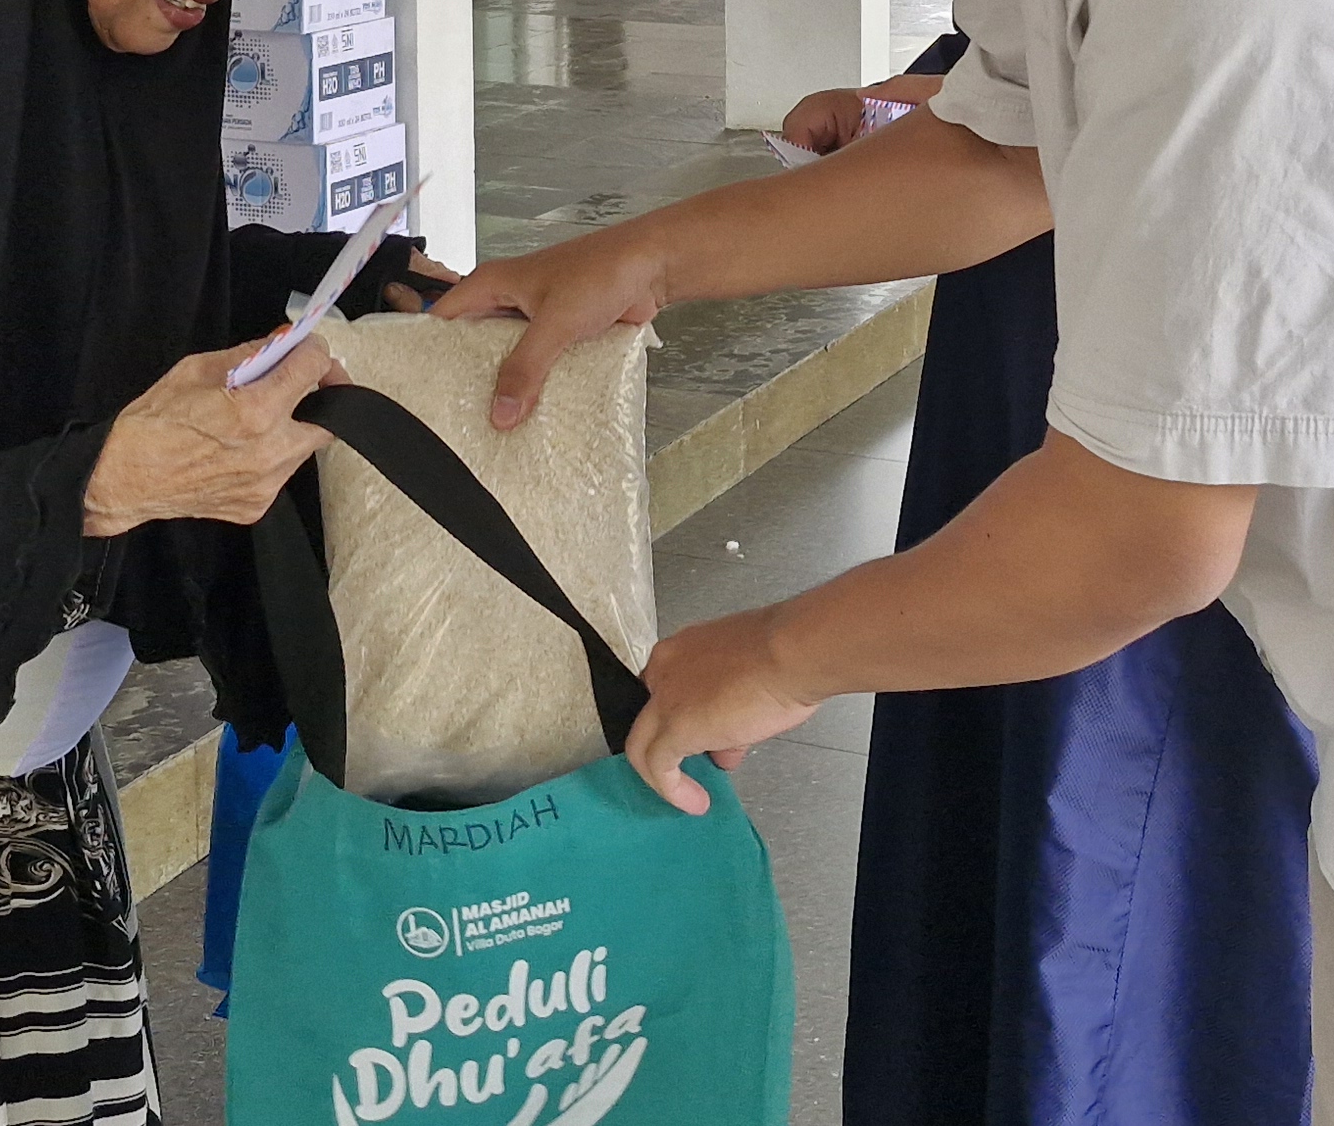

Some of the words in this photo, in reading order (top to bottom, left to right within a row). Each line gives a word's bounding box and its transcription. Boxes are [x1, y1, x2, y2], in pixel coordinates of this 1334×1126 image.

[342, 33, 354, 49] SNI
[373, 60, 385, 79] PH
[322, 77, 338, 96] H2O
[354, 146, 367, 163] SNI
[384, 171, 396, 189] PH
[335, 190, 351, 211] H2O
[384, 794, 559, 856] MARDIAH
[461, 891, 530, 921] MASJID
[465, 920, 488, 937] AL
[489, 897, 571, 932] AMANAH
[466, 938, 494, 951] Villa
[495, 929, 526, 945] Duta
[527, 920, 564, 936] Bogor
[381, 946, 608, 1048] Peduli
[348, 1005, 647, 1121] Dhu'afa
